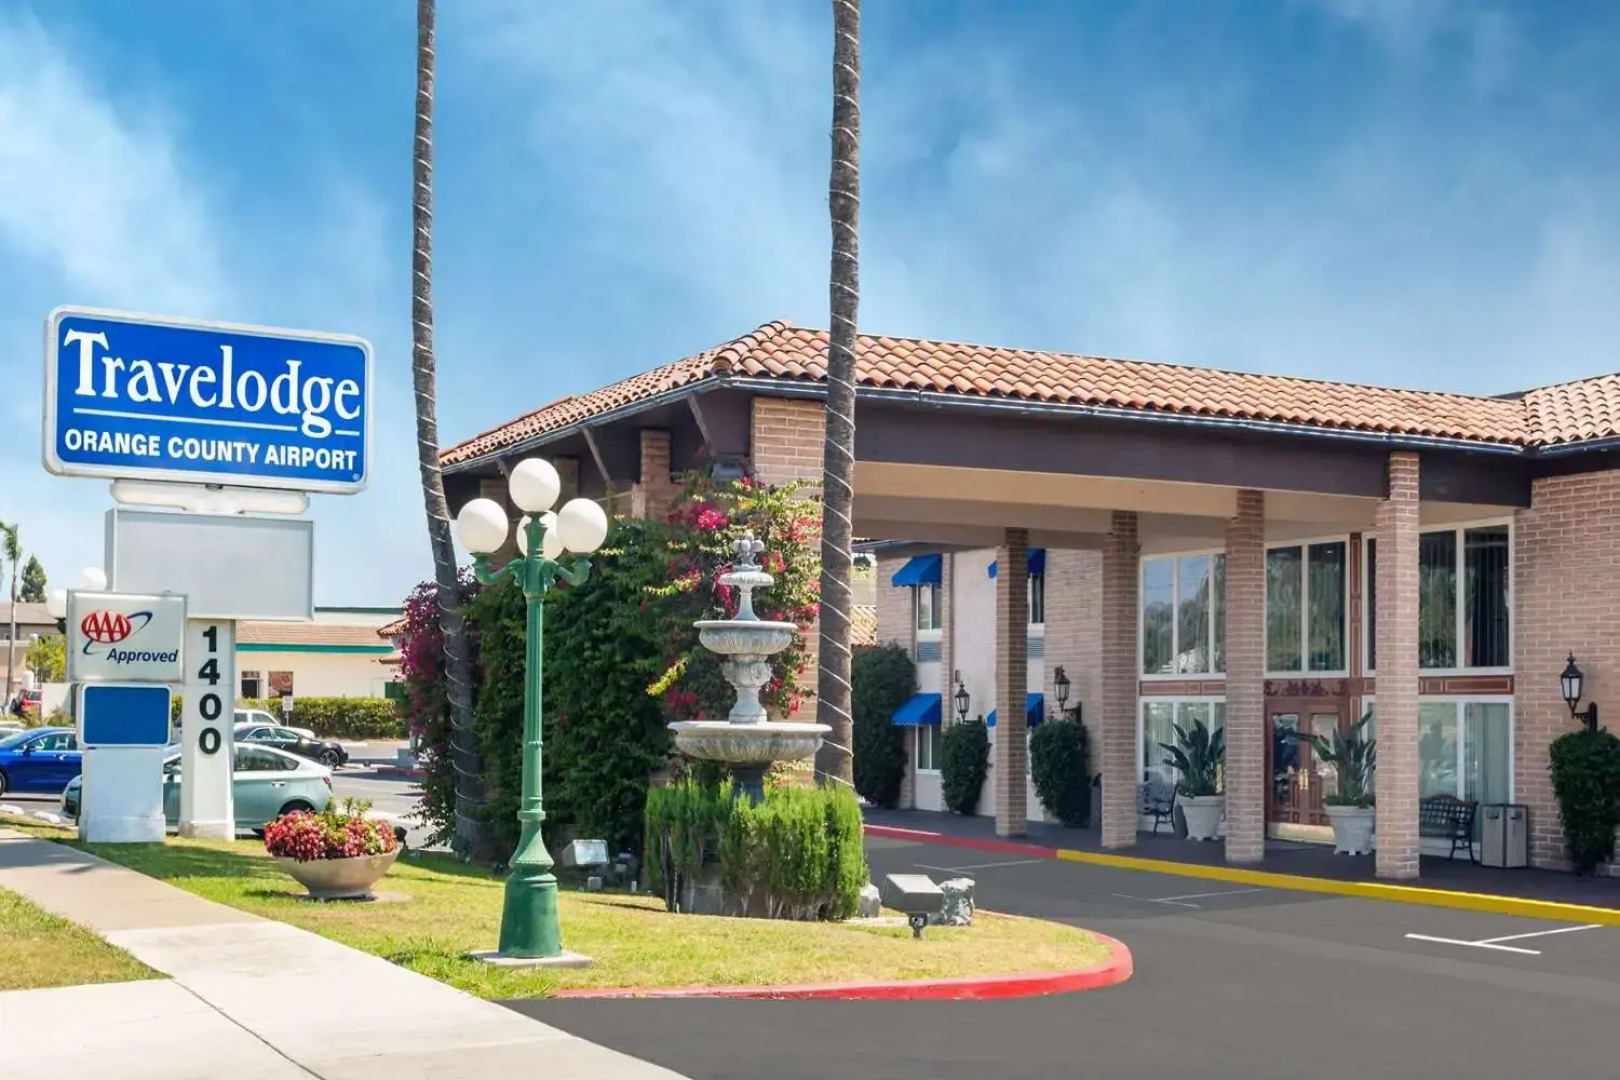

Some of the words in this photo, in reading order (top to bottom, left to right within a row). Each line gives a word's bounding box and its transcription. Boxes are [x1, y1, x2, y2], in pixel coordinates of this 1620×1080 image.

[63, 329, 361, 438] Travelodge
[65, 428, 161, 457] ORANGE
[168, 436, 260, 463] COUNTY
[264, 444, 357, 471] AIRPORT
[85, 611, 128, 643] AAA
[107, 648, 179, 664] Approved
[198, 625, 222, 755] 1400
